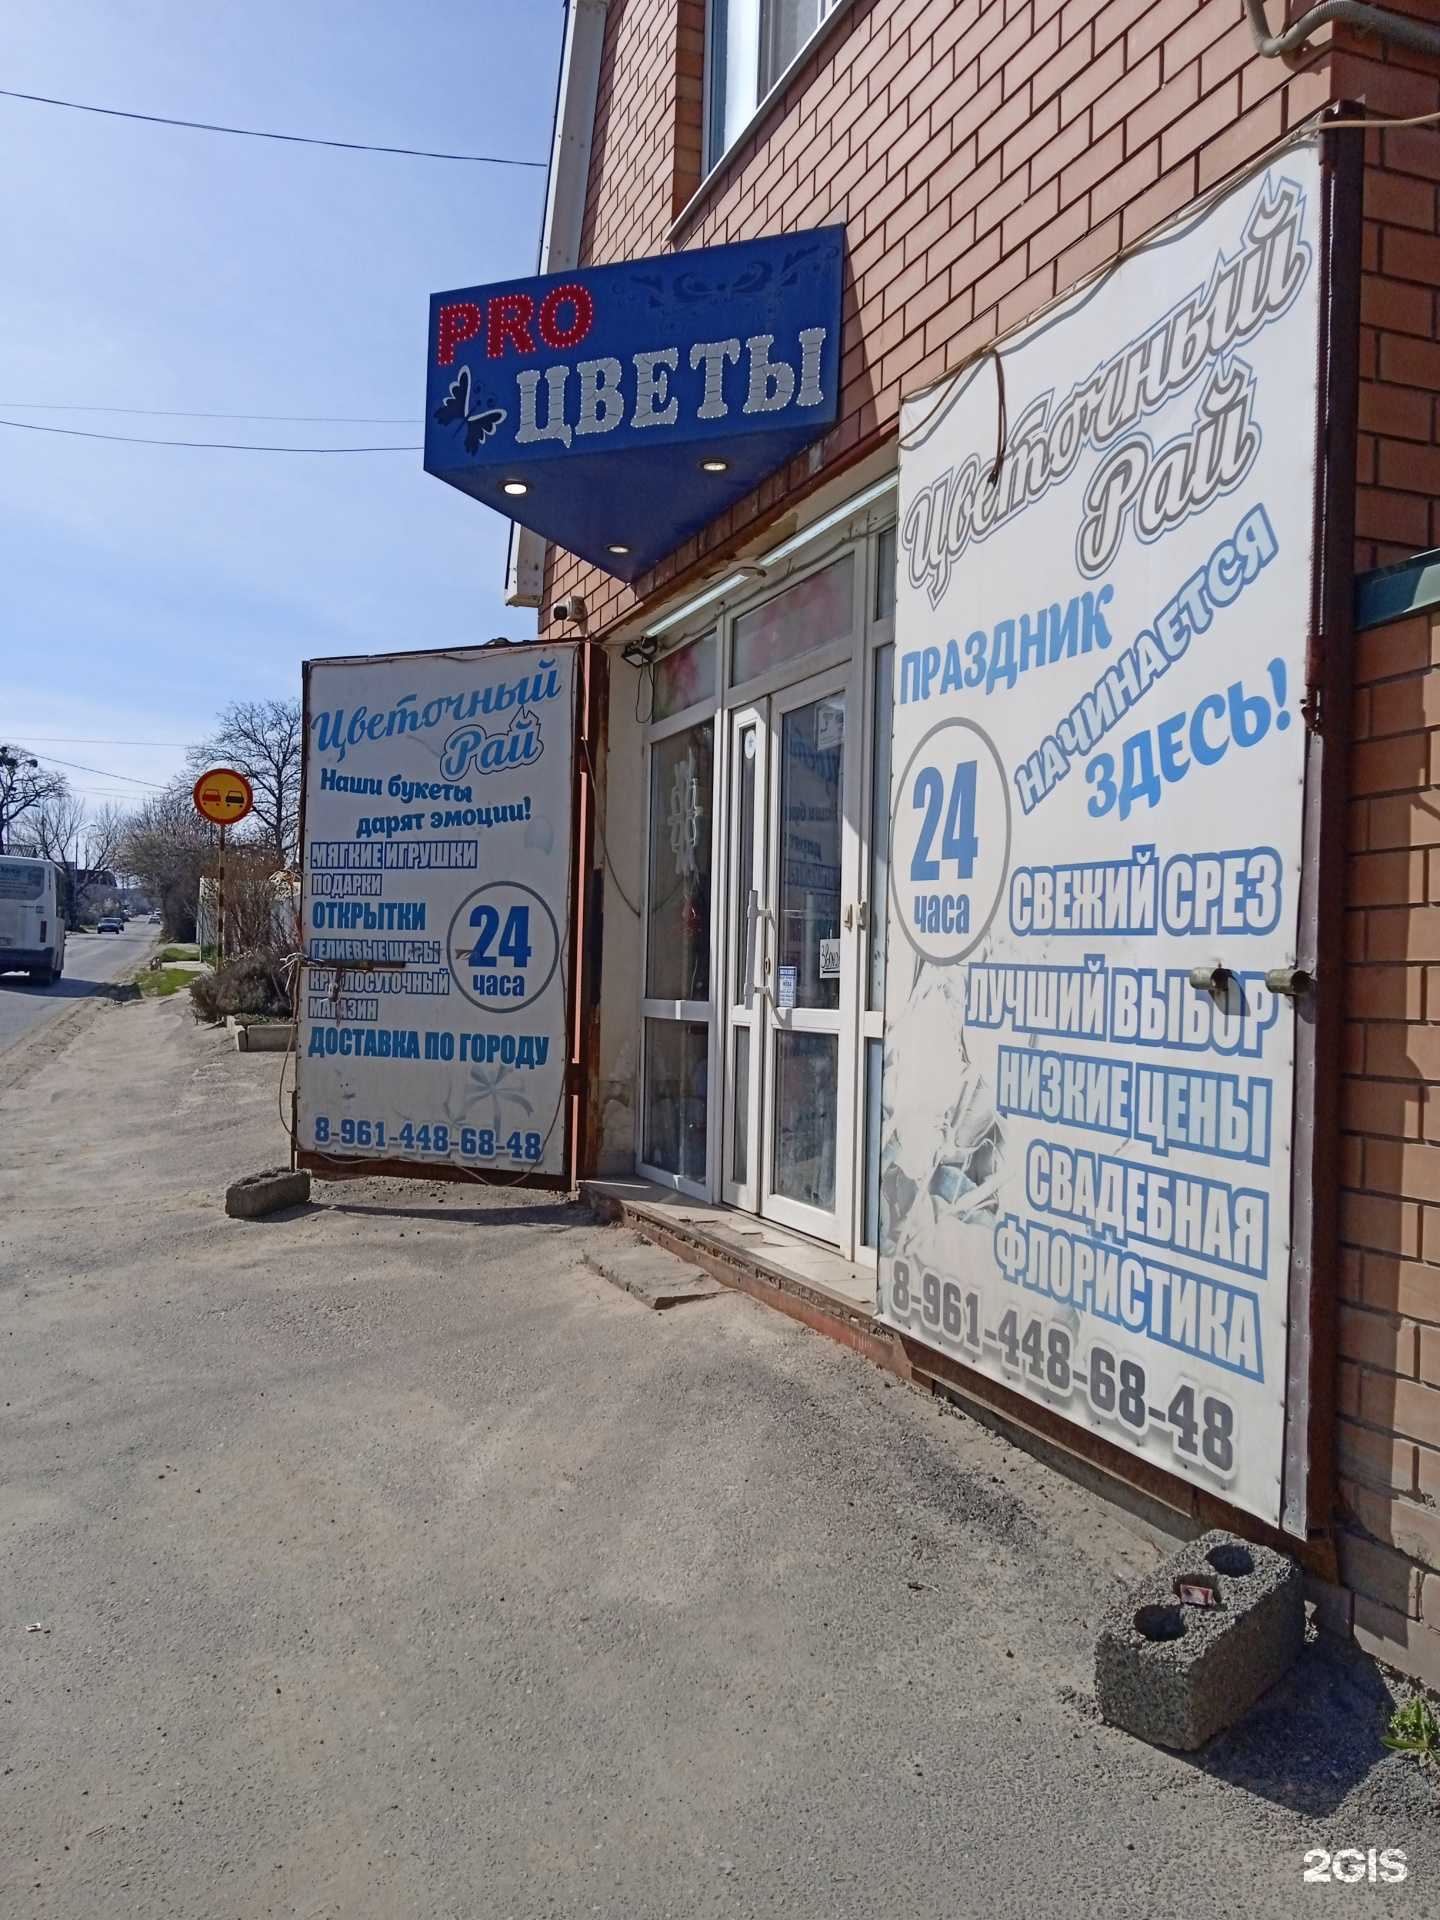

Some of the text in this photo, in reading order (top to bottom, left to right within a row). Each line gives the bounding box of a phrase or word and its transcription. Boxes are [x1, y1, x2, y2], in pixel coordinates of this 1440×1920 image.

[437, 283, 593, 366] PRO
[514, 327, 827, 448] ЦВЕТЫ
[902, 172, 1311, 606] Цветочный
[1078, 358, 1260, 576] Рай
[900, 584, 1114, 705] ПРАЗДНИК
[1014, 502, 1279, 816] НАЧИНАЕТСЯ
[311, 658, 561, 762] Цветочный
[444, 716, 541, 778] Рай
[1085, 657, 1292, 821] ЗДЕСЬ!
[320, 767, 473, 803] Наши букеты
[355, 796, 532, 838] дарят эмоции!
[910, 760, 978, 882] 24
[311, 840, 478, 869] МЯГКИЕ ИГРУШКИ
[312, 874, 382, 898] ПОДАРКИ
[1009, 844, 1283, 936] СВЕЖИЙ СРЕЗ
[310, 938, 440, 964] ГЕЛИЕВЫЕ ШАРЫ
[312, 902, 426, 930] ОТКРЫТКИ
[469, 905, 531, 968] 24
[914, 894, 970, 934] часа
[473, 974, 524, 996] часа
[964, 954, 1106, 1041] ЛУЧШИЙ
[308, 1027, 549, 1069] ДОСТАВКА ПО ГОРОДУ
[314, 1116, 541, 1160] 8-961-448-68-48
[997, 1045, 1273, 1167] НИЗКИЕ ЦЕНЫ
[1026, 1139, 1270, 1280] СВАДЕБНАЯ
[994, 1212, 1265, 1384] ФЛОРИСТИКА
[890, 1258, 1236, 1475] 8-961-448-68-48
